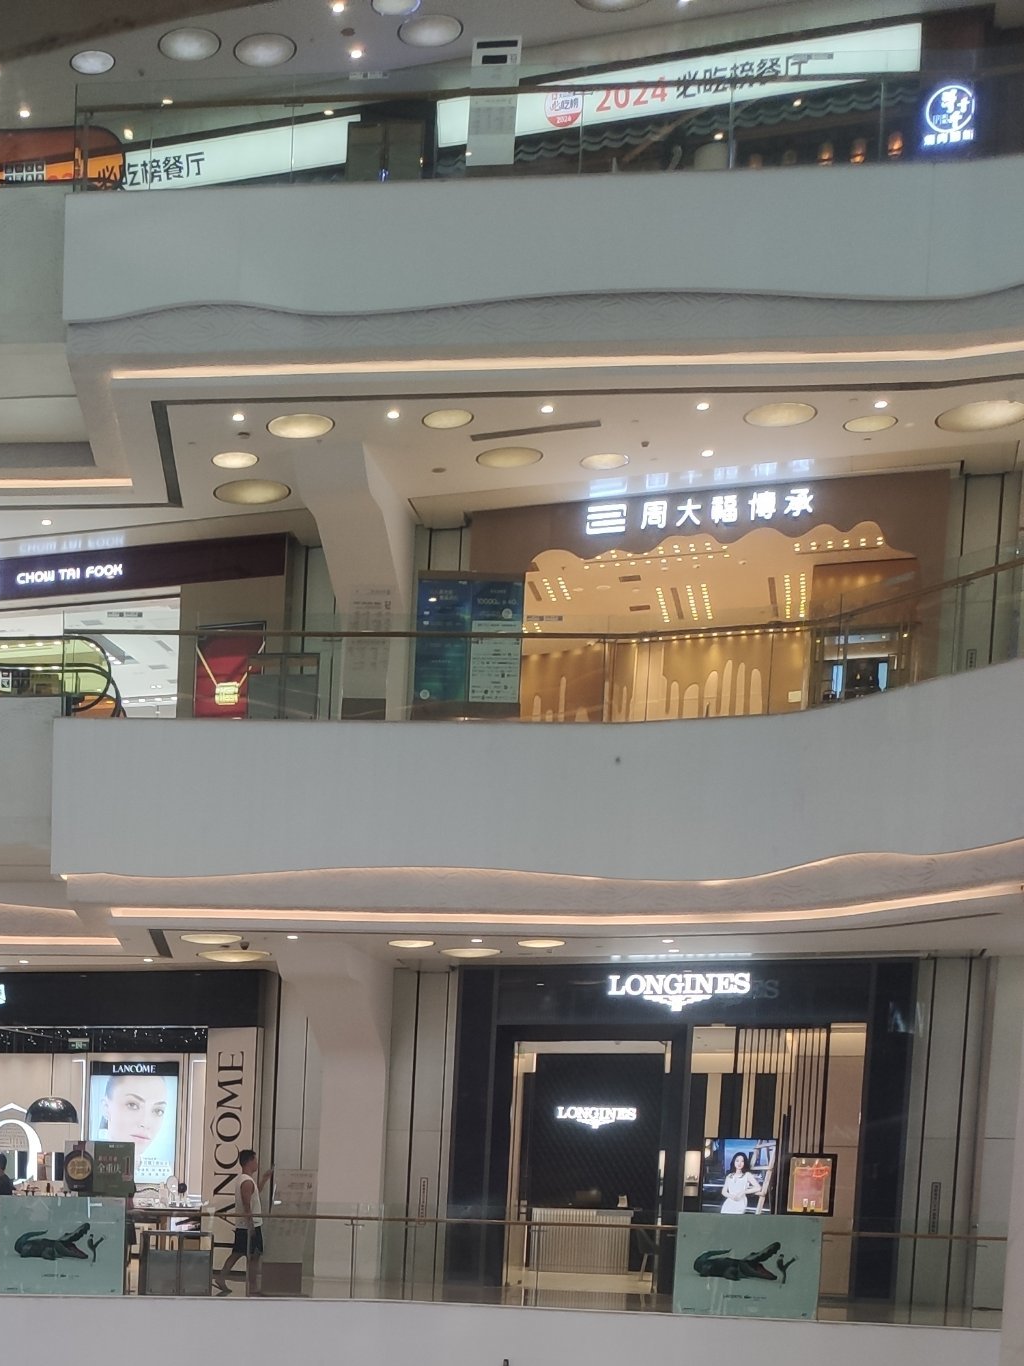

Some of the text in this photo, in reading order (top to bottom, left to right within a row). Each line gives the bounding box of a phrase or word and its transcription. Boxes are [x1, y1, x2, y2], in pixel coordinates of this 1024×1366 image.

[595, 76, 669, 112] 2024
[16, 570, 55, 585] CHOW
[58, 567, 81, 581] TAI
[85, 563, 124, 580] FOOK
[607, 973, 751, 996] LONGINES
[112, 1063, 156, 1074] LANCÔME
[556, 1106, 636, 1121] LONGINES
